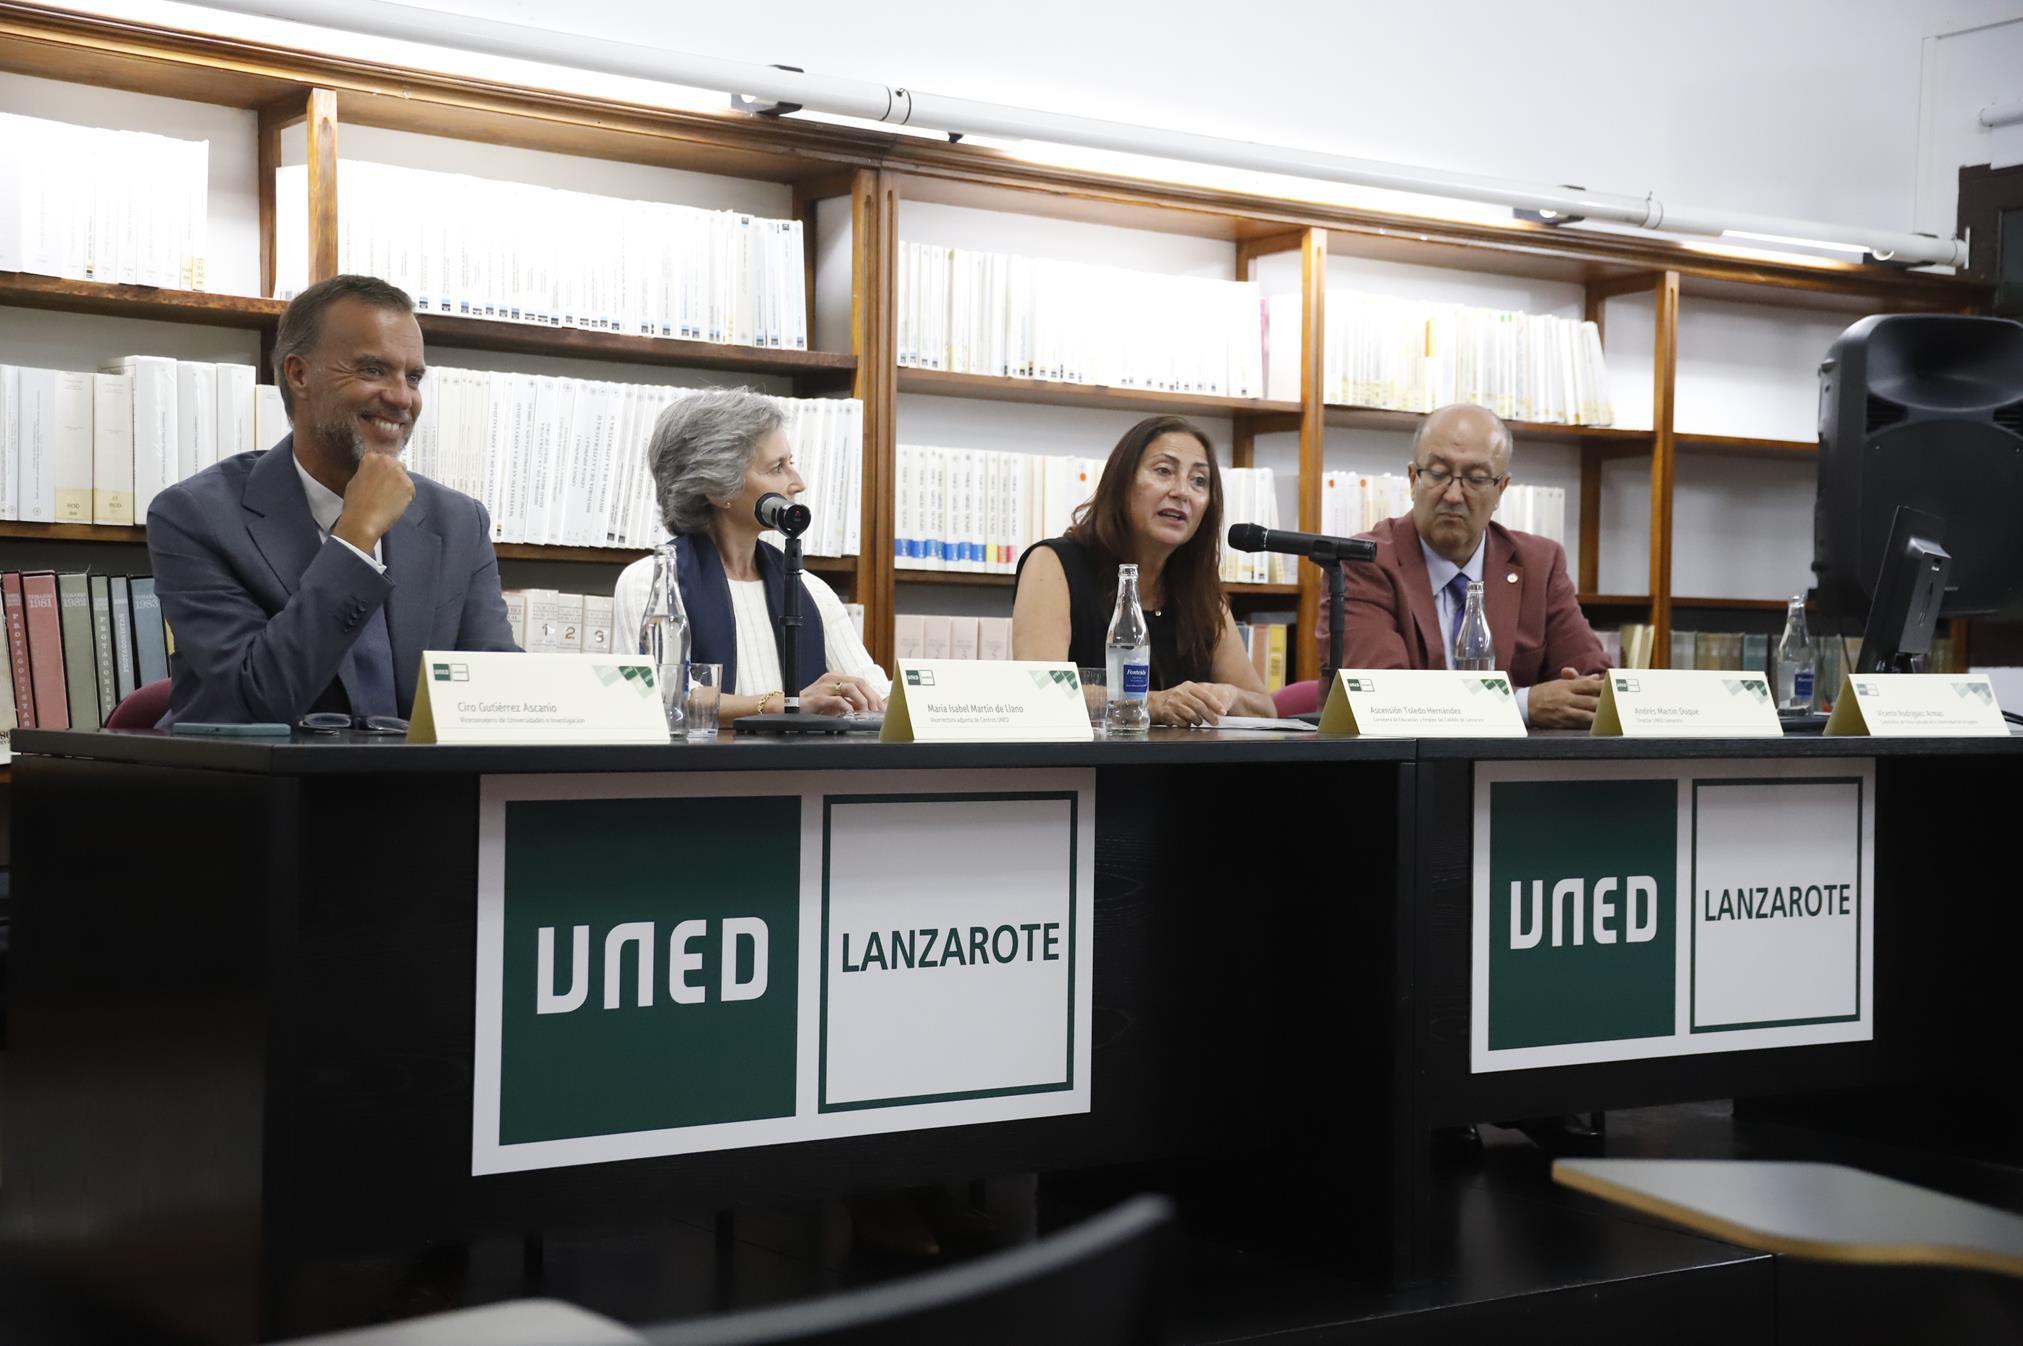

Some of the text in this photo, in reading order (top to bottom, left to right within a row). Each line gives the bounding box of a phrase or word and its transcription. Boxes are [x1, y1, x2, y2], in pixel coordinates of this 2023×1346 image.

[135, 599, 159, 609] 1983
[564, 626, 576, 640] 2
[594, 630, 604, 643] 3
[457, 702, 557, 712] Ciro Gutiérrez Ascanio
[949, 704, 969, 713] Isabel
[995, 704, 1005, 713] de
[1403, 706, 1426, 714] Toledo
[1704, 883, 1851, 922] LANZAROTE
[1510, 875, 1658, 950] UNED
[842, 922, 1060, 973] LANZAROTE
[537, 916, 769, 1014] UNED
